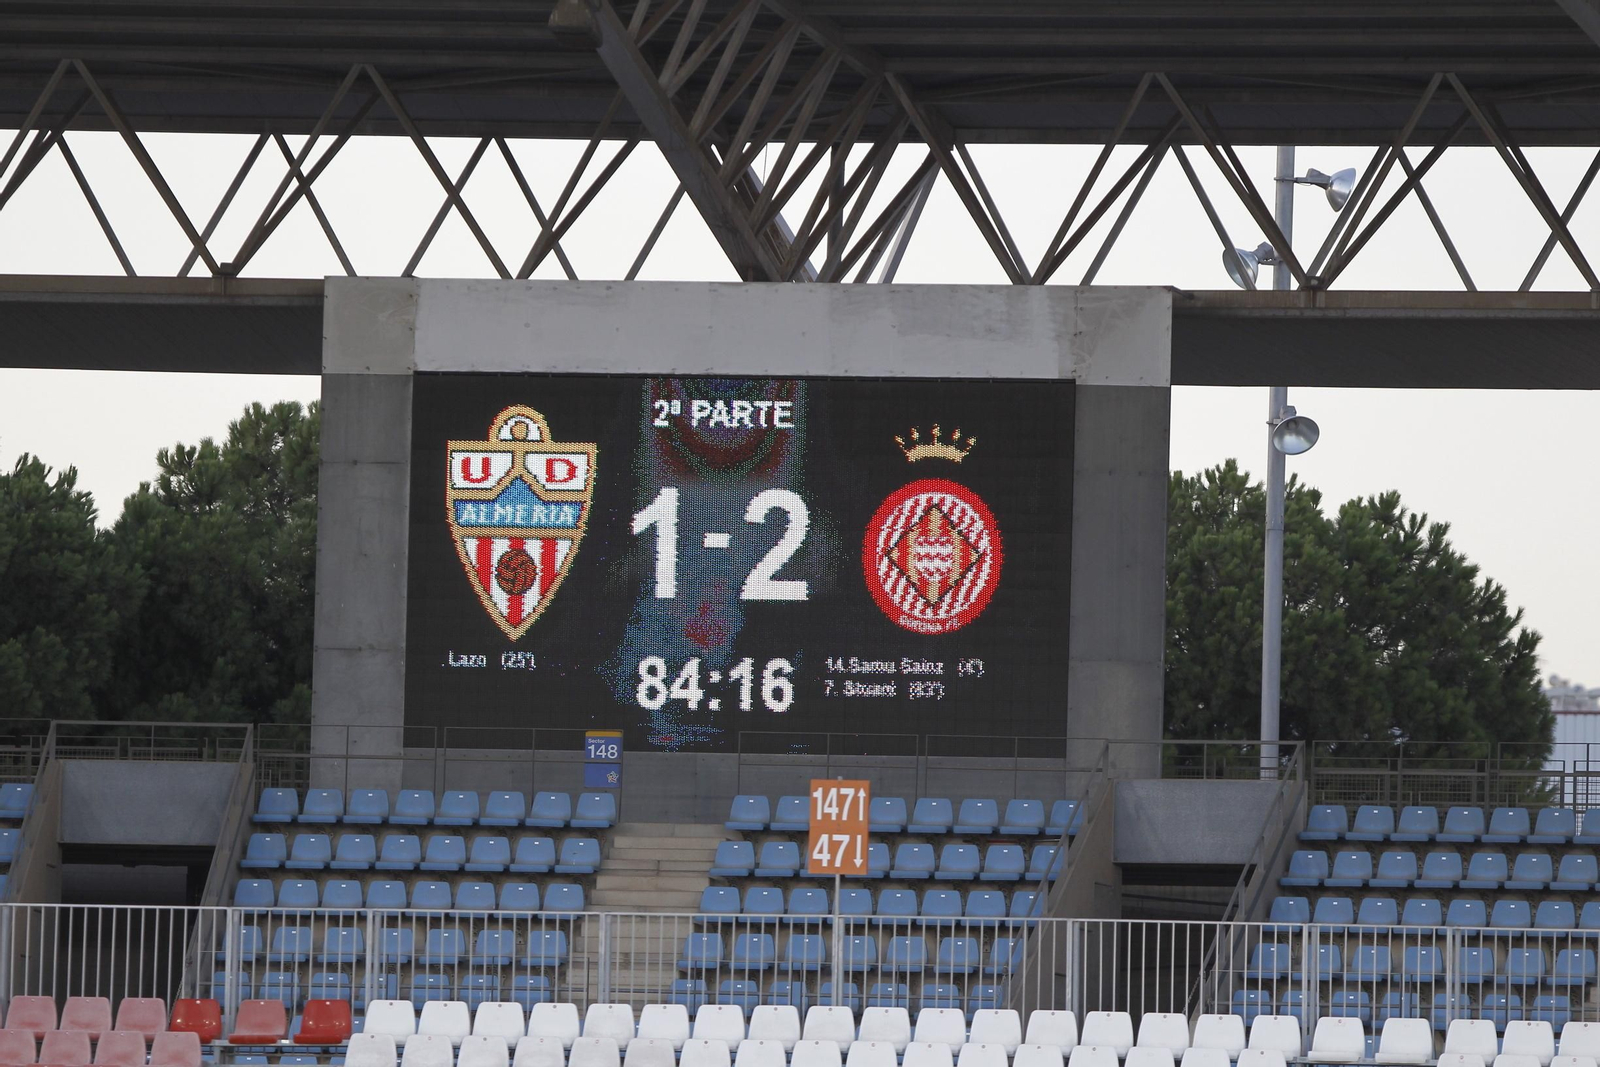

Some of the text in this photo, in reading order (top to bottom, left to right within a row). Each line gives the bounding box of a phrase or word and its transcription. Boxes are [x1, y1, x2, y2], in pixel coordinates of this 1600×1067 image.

[692, 399, 795, 429] PARTE
[461, 456, 577, 484] U D
[448, 650, 487, 668] Lazo
[637, 656, 796, 713] 84:16
[587, 744, 618, 759] 148
[812, 787, 856, 821] 147
[812, 833, 851, 868] 47
